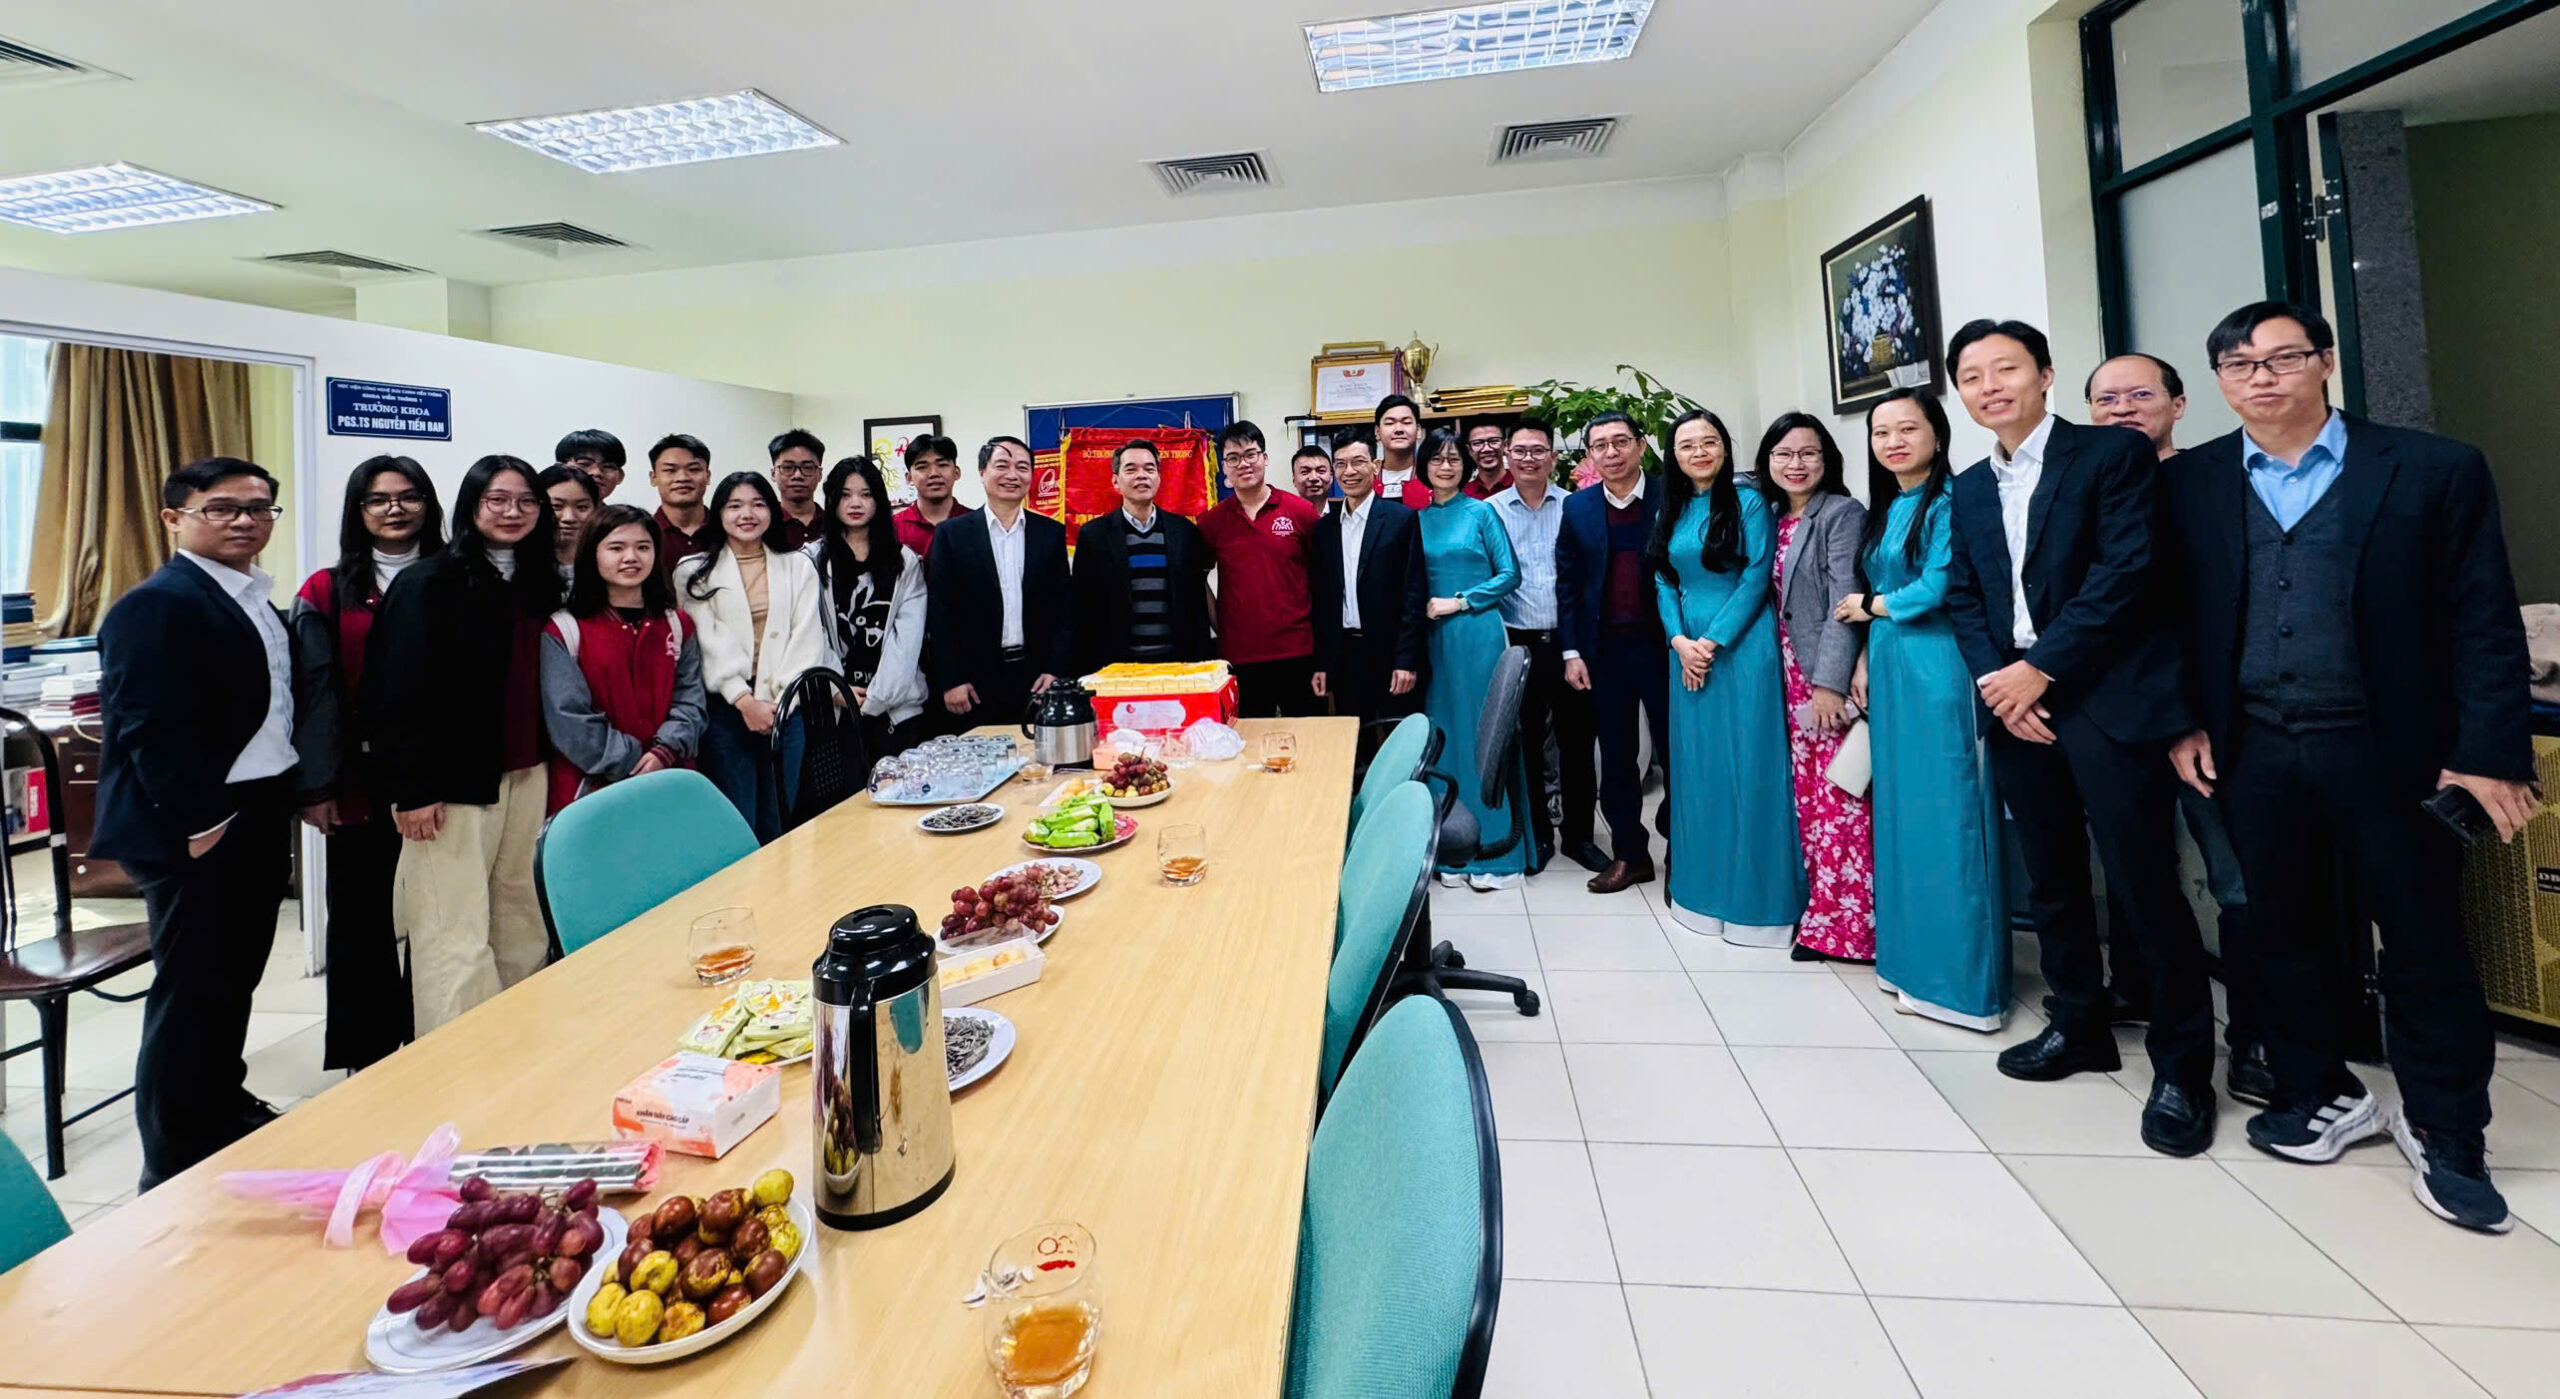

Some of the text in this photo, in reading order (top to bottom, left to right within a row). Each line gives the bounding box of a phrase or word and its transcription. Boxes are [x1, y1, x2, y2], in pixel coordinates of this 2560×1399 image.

[352, 400, 430, 416] TRƯỞNG KHOA
[338, 416, 370, 428] PGS.TS
[407, 416, 426, 432] TIẾN
[427, 421, 445, 432] BAN
